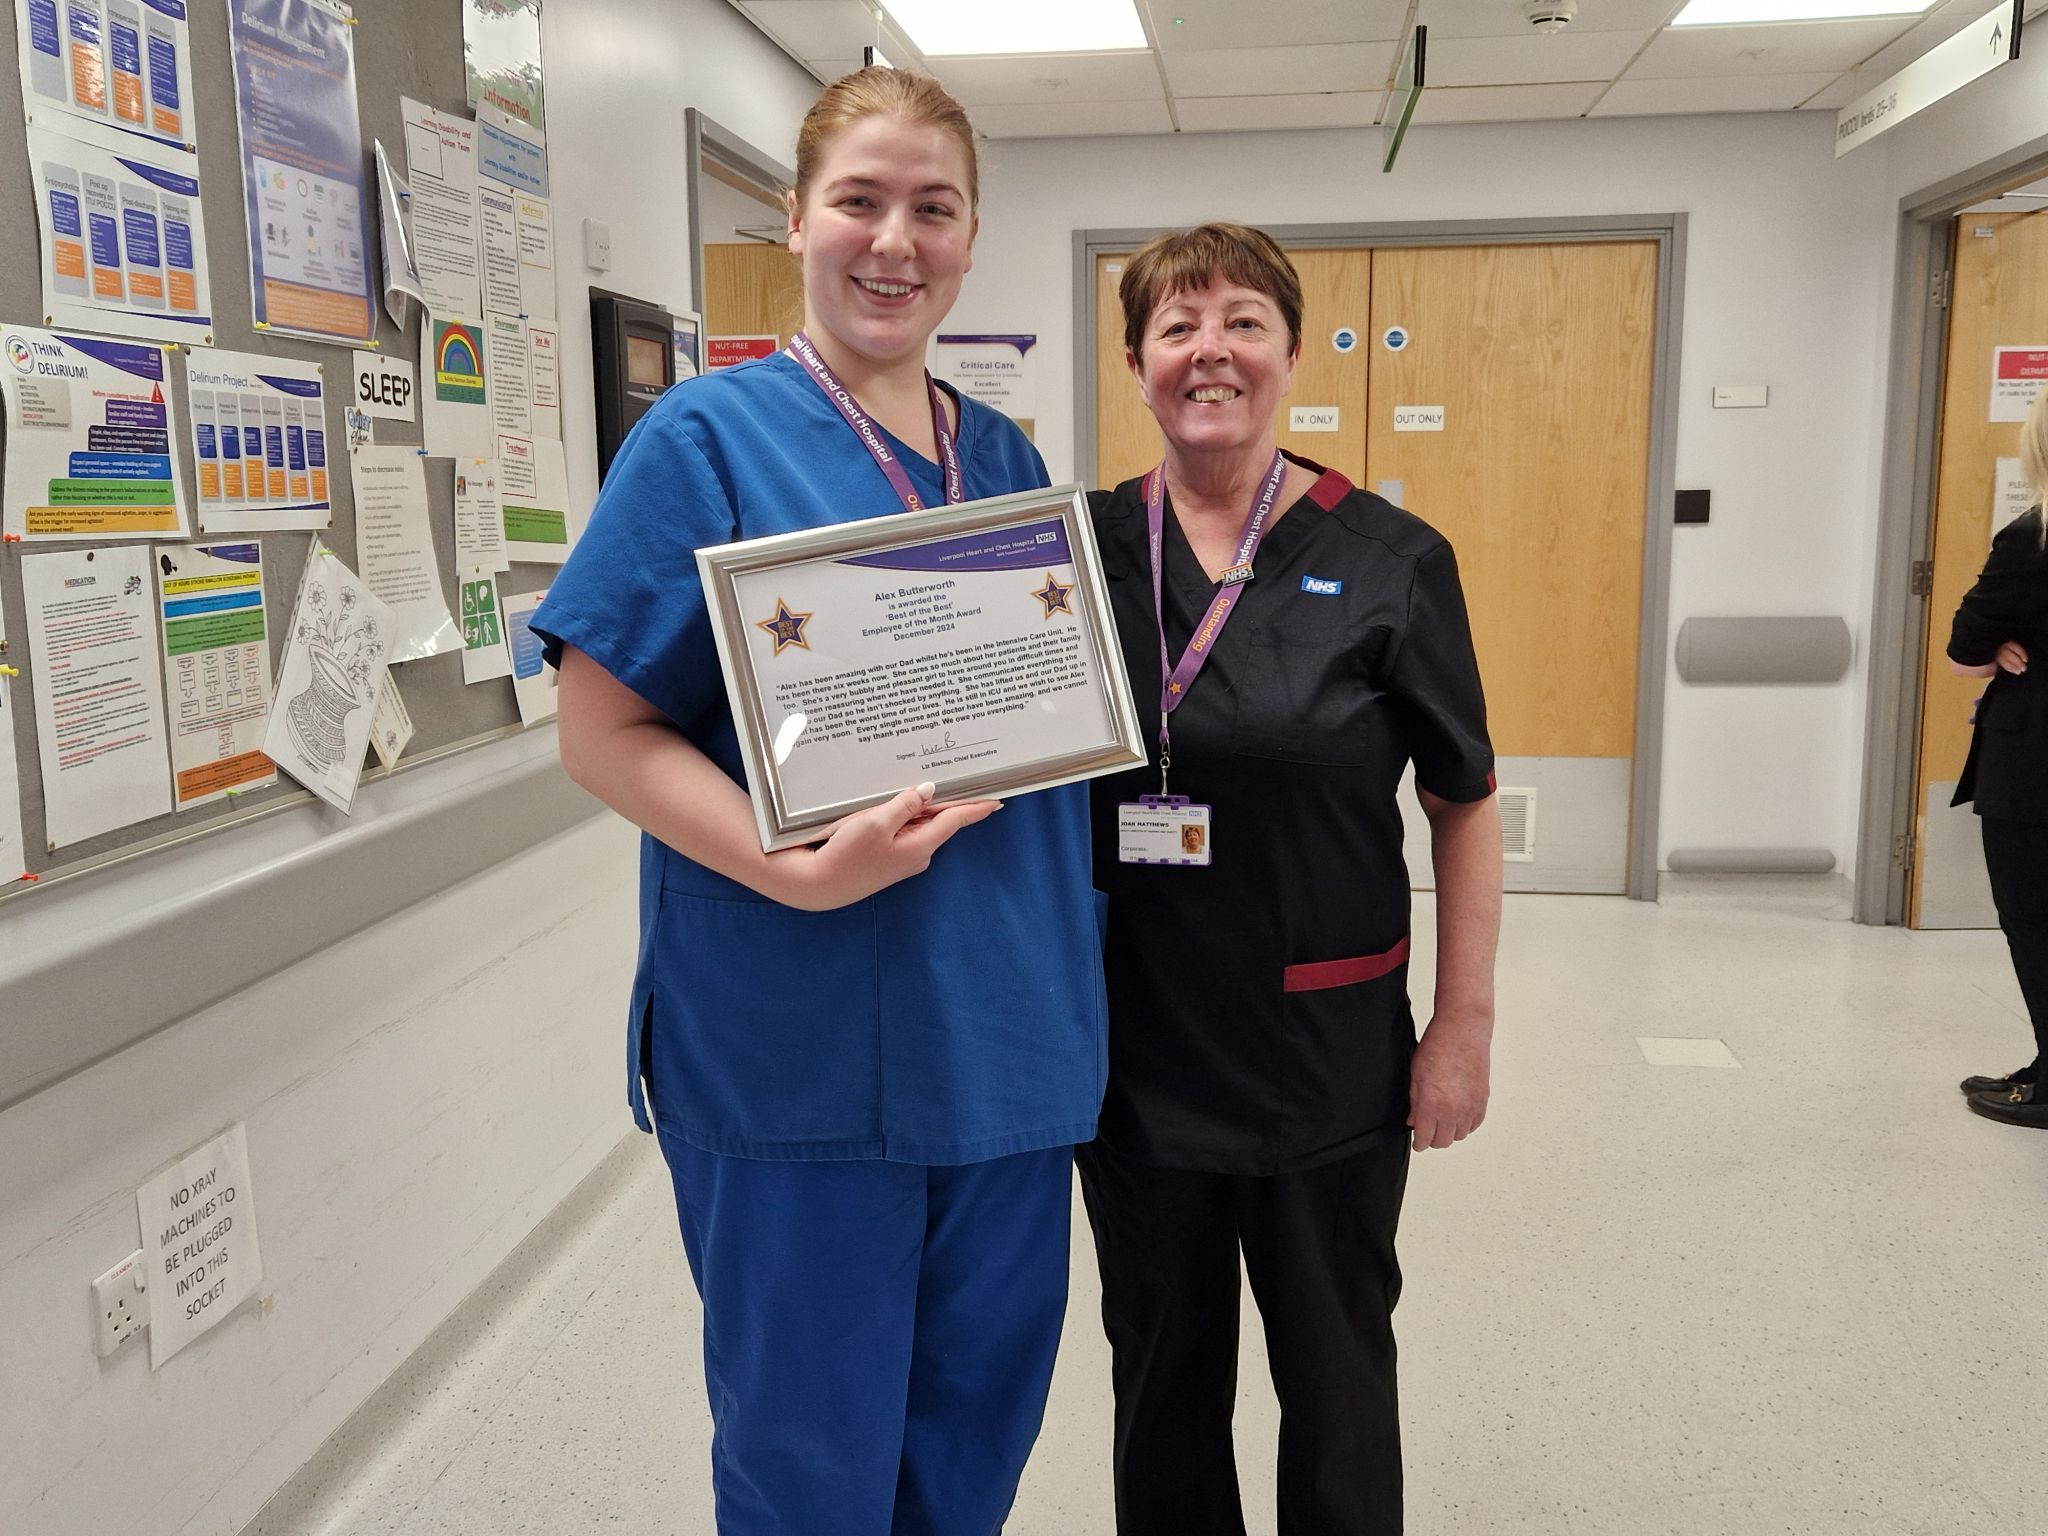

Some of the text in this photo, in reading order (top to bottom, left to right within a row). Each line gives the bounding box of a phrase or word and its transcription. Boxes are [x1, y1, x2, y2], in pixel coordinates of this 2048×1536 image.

[242, 12, 326, 60] Delirium Management
[484, 88, 530, 120] Information
[439, 122, 460, 138] Disability
[462, 130, 472, 139] and
[457, 142, 470, 152] Team
[481, 193, 512, 212] Communication
[494, 317, 519, 330] Environment
[32, 342, 64, 357] THINK
[38, 362, 88, 379] DELIRIUM!
[190, 370, 248, 388] Delirium Project
[360, 372, 410, 407] SLEEP
[800, 345, 892, 462] Heart and Chest Hospital
[1295, 415, 1333, 424] IN ONLY
[1396, 414, 1442, 424] OUT ONLY
[506, 442, 528, 454] Treatment
[950, 470, 960, 499] Chest
[1236, 459, 1286, 566] Heart and Chest Hospit
[938, 551, 965, 562] Liverpool
[1011, 538, 1035, 548] Hospital
[1038, 533, 1054, 542] NHS
[64, 576, 96, 586] MEDICATION
[1225, 567, 1249, 584] NHS
[1306, 580, 1337, 593] NHS
[873, 579, 955, 601] Alex Butterworth
[897, 596, 932, 608] awarded
[862, 622, 902, 638] Employee
[914, 617, 927, 626] the
[928, 612, 954, 623] Month
[955, 607, 981, 618] Award
[918, 606, 931, 614] the
[893, 622, 955, 640] December 2024
[1192, 598, 1230, 652] Outstanding
[791, 689, 810, 698] been
[812, 684, 831, 693] there
[845, 677, 869, 687] weeks
[940, 658, 961, 667] much
[962, 654, 983, 663] about
[997, 645, 1026, 657] patients
[1042, 638, 1058, 646] their
[1060, 634, 1081, 645] family
[814, 674, 833, 683] been
[834, 668, 866, 681] amazing
[867, 664, 883, 672] with
[915, 653, 937, 663] whilst
[954, 646, 973, 655] been
[996, 635, 1027, 646] Intensive
[1029, 632, 1046, 640] Care
[1047, 628, 1063, 636] Unit.
[783, 701, 797, 709] too.
[802, 696, 823, 705] She's
[831, 692, 848, 701] very
[849, 685, 875, 697] bubbly
[892, 675, 923, 688] pleasant
[924, 672, 937, 682] girl
[947, 667, 964, 675] have
[966, 661, 991, 671] around
[993, 660, 1007, 668] you
[1016, 651, 1043, 661] difficult
[1043, 647, 1063, 656] times
[858, 736, 871, 744] say
[872, 730, 893, 739] thank
[895, 727, 909, 736] you
[910, 720, 940, 732] enough.
[971, 711, 985, 720] you
[931, 758, 953, 768] Bishop,
[969, 748, 997, 758] Executive
[170, 1168, 217, 1211] NO XRAY
[160, 1187, 235, 1249] MACHINES TO
[165, 1216, 232, 1275] BE PLUGGED
[176, 1247, 228, 1297] INTO THIS
[186, 1278, 226, 1320] SOCKET
